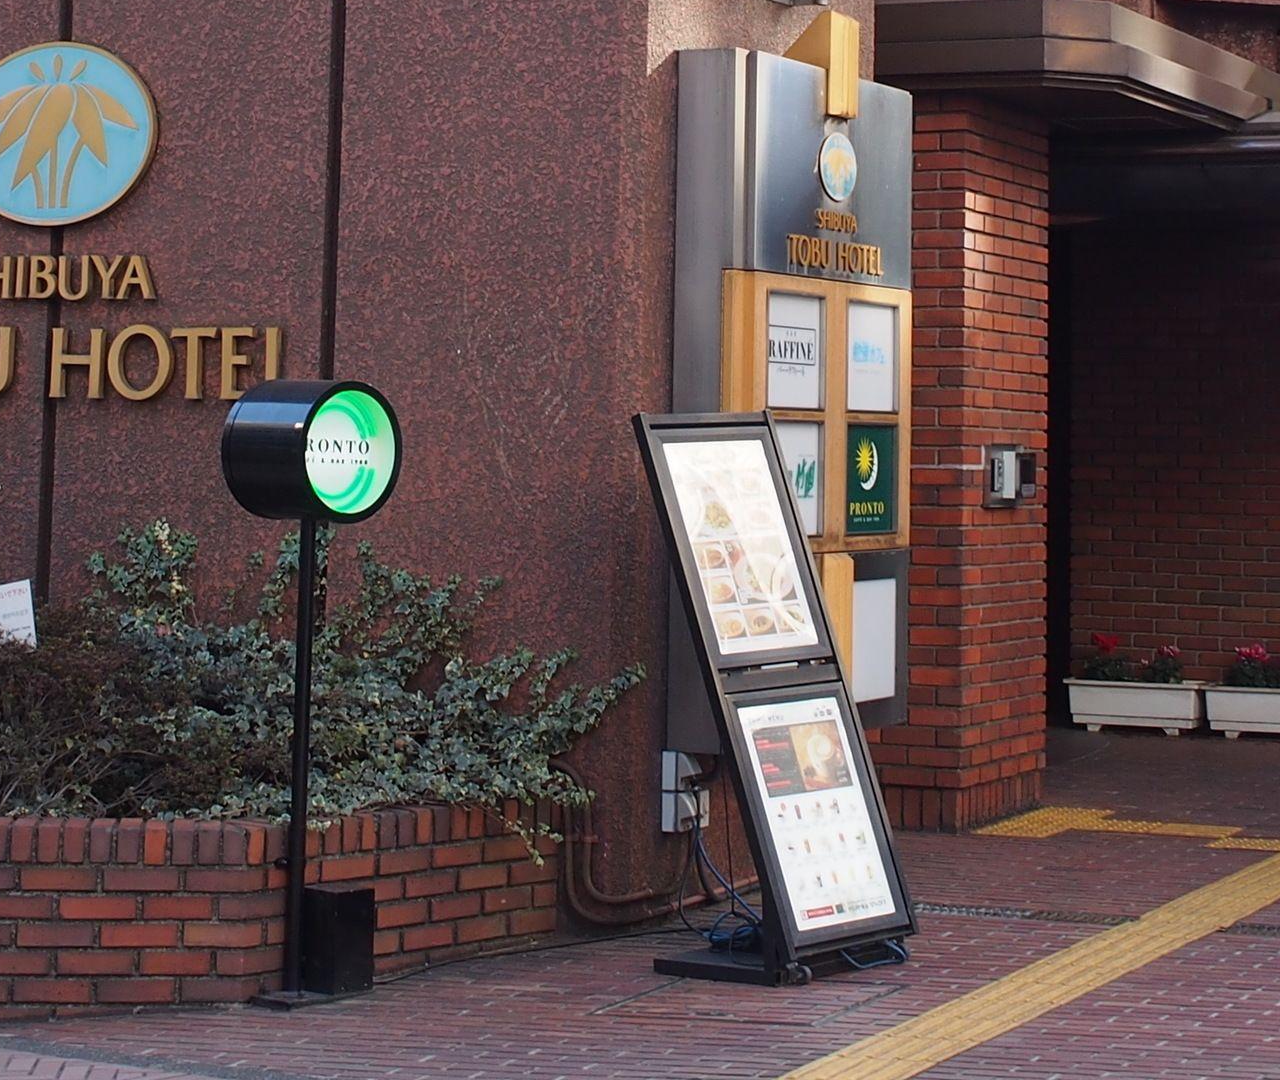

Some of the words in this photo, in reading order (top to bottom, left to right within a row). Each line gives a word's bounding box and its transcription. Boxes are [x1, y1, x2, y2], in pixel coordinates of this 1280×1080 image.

[815, 207, 858, 234] SHIBUYA
[785, 233, 832, 270] TOBU
[834, 240, 885, 277] HOTEL
[306, 438, 370, 455] RONTO
[849, 501, 885, 516] PRONTO
